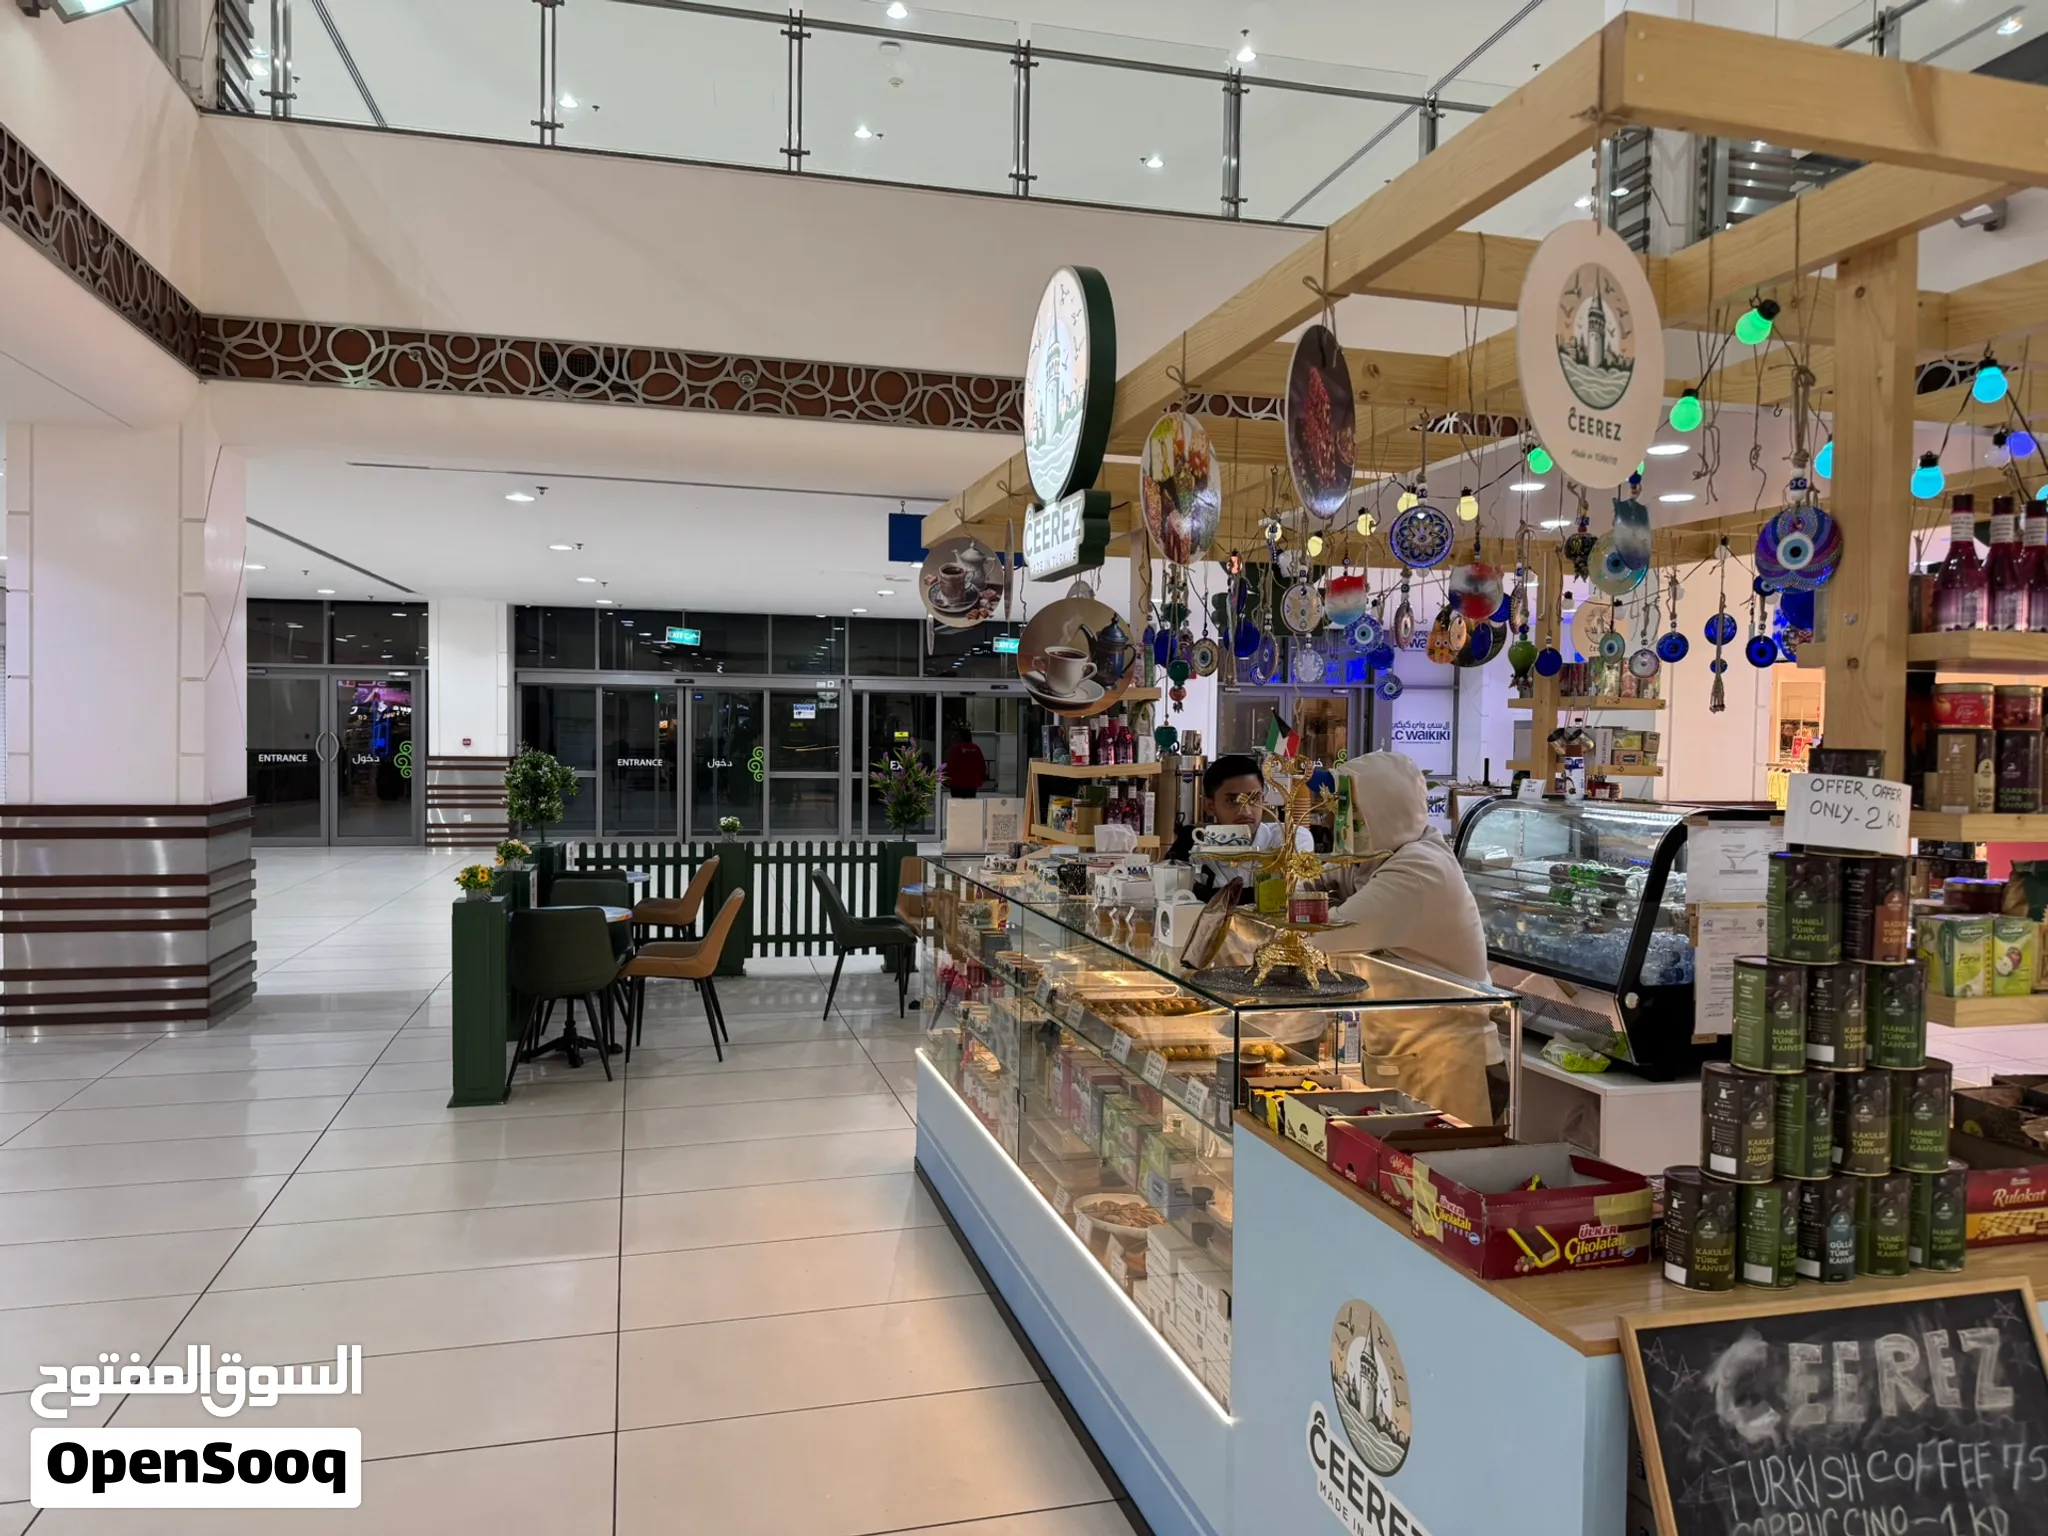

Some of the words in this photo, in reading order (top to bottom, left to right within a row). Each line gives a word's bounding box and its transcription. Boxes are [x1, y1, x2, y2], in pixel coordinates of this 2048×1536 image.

[258, 754, 308, 762] ENTRANCE
[352, 754, 380, 764] دخول
[617, 759, 663, 767] ENTRANCE
[707, 758, 733, 768] دخول
[1872, 784, 1902, 801] OFFER
[1865, 806, 1883, 829] 2
[1993, 1188, 2046, 1207] Rulokat
[1580, 1224, 1618, 1239] ÜLKER
[1695, 1255, 1718, 1264] TÜRK
[1707, 1327, 2014, 1443] CEEREZ
[1712, 1453, 1865, 1520] TURKISH
[1867, 1438, 1992, 1492] COFFEE
[1320, 1480, 1349, 1522] MADE
[1353, 1517, 1365, 1536] IN
